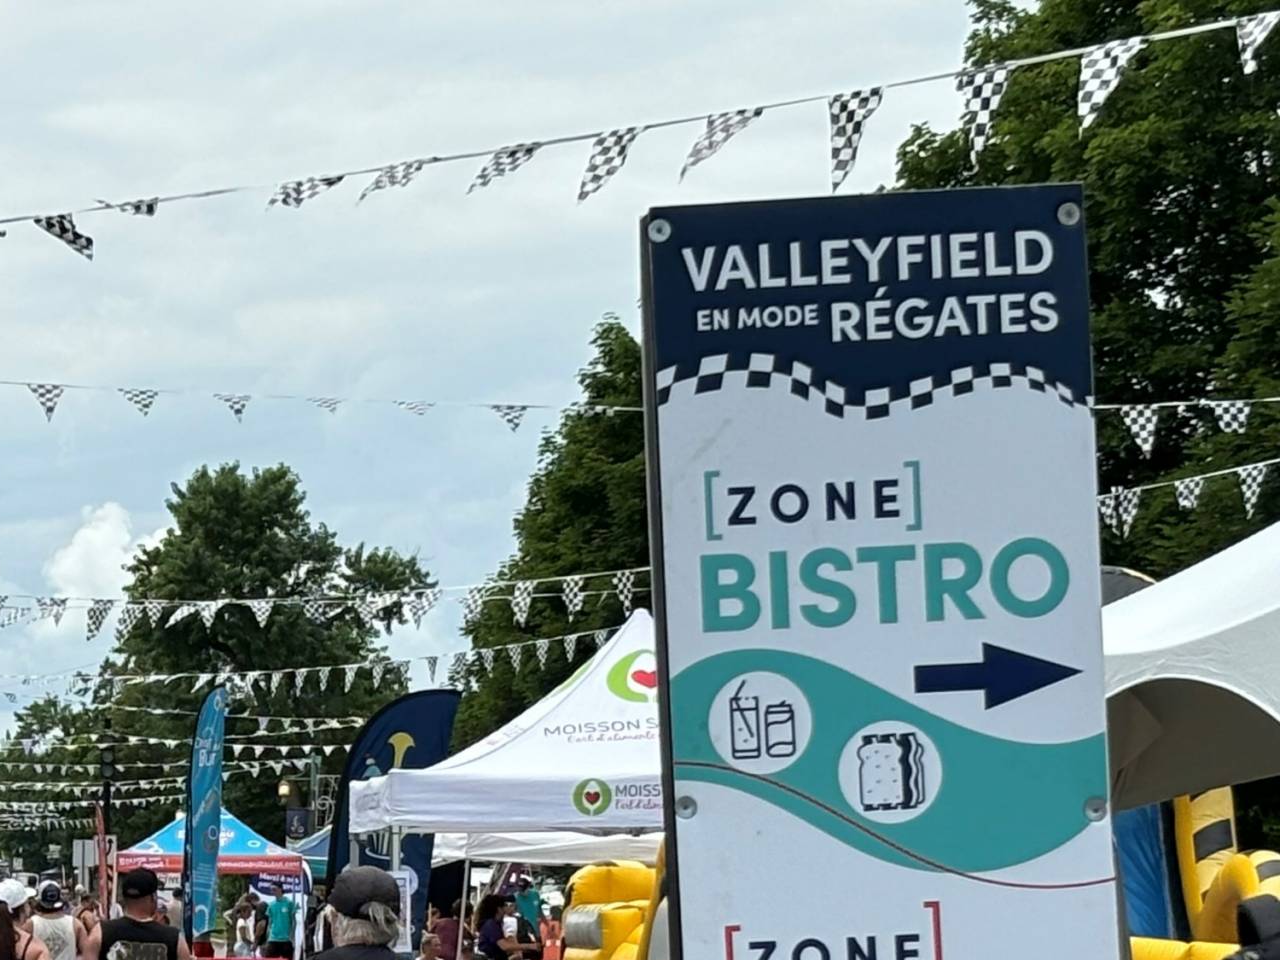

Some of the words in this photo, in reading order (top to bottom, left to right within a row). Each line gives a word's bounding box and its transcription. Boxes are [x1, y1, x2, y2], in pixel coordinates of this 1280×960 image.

[681, 229, 1054, 293] VALLEYFIELD
[696, 308, 731, 332] EN
[737, 304, 819, 329] MODE
[830, 287, 1059, 343] RÉGATES
[699, 536, 1070, 633] BISTRO
[544, 719, 641, 736] MOISSON
[615, 784, 661, 798] MOISS
